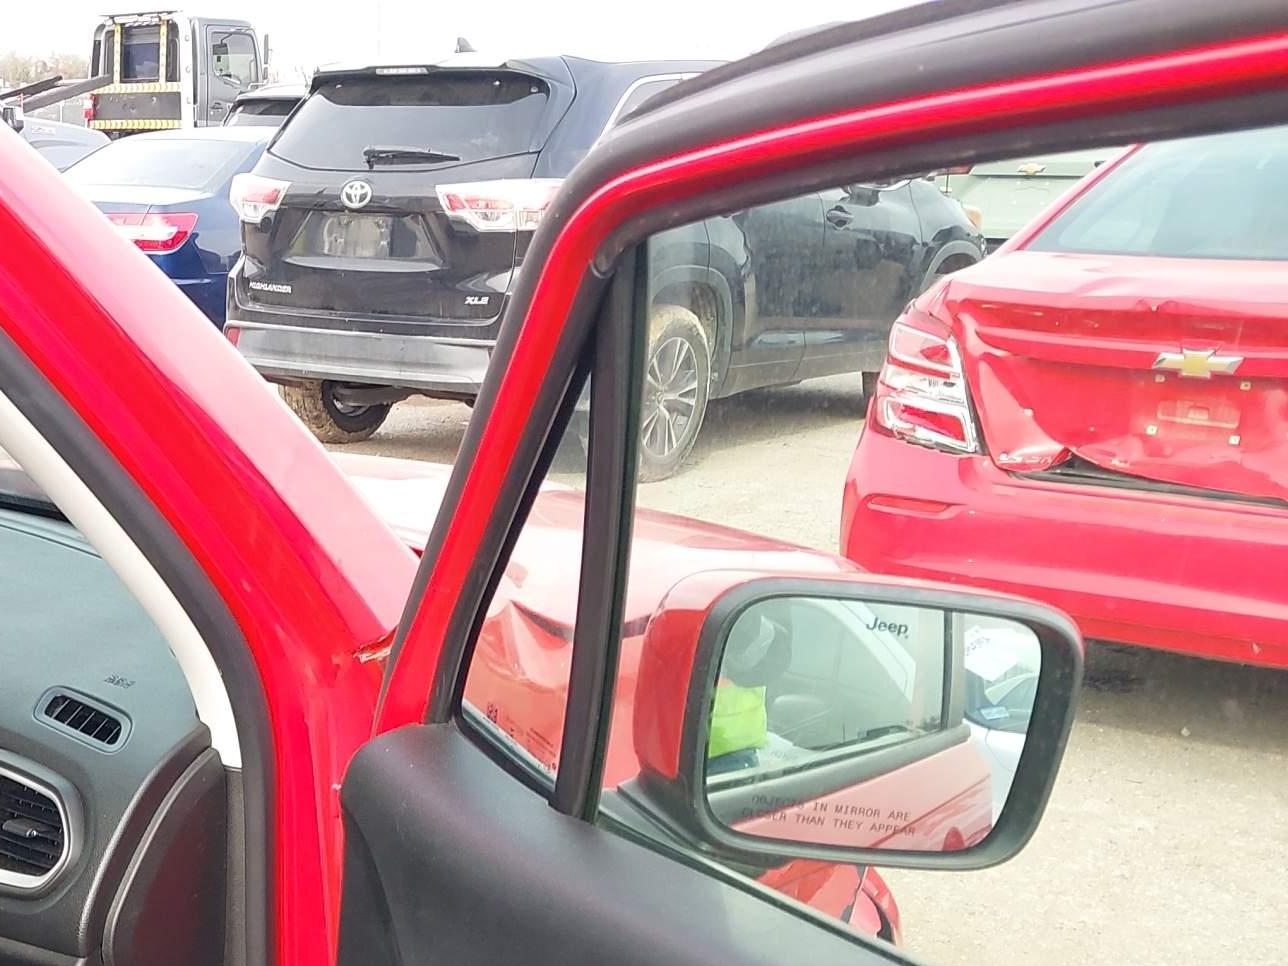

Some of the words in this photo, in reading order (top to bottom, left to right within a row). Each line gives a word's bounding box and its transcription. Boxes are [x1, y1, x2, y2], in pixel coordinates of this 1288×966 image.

[248, 281, 292, 294] HIGHLANDER
[464, 295, 489, 305] XLE
[865, 616, 909, 637] Jeep
[813, 802, 828, 813] IN
[834, 805, 881, 818] MIRROR
[887, 810, 912, 822] ARE
[795, 813, 825, 826] THAN
[833, 819, 863, 831] THEY
[870, 823, 917, 836] APPEAR
